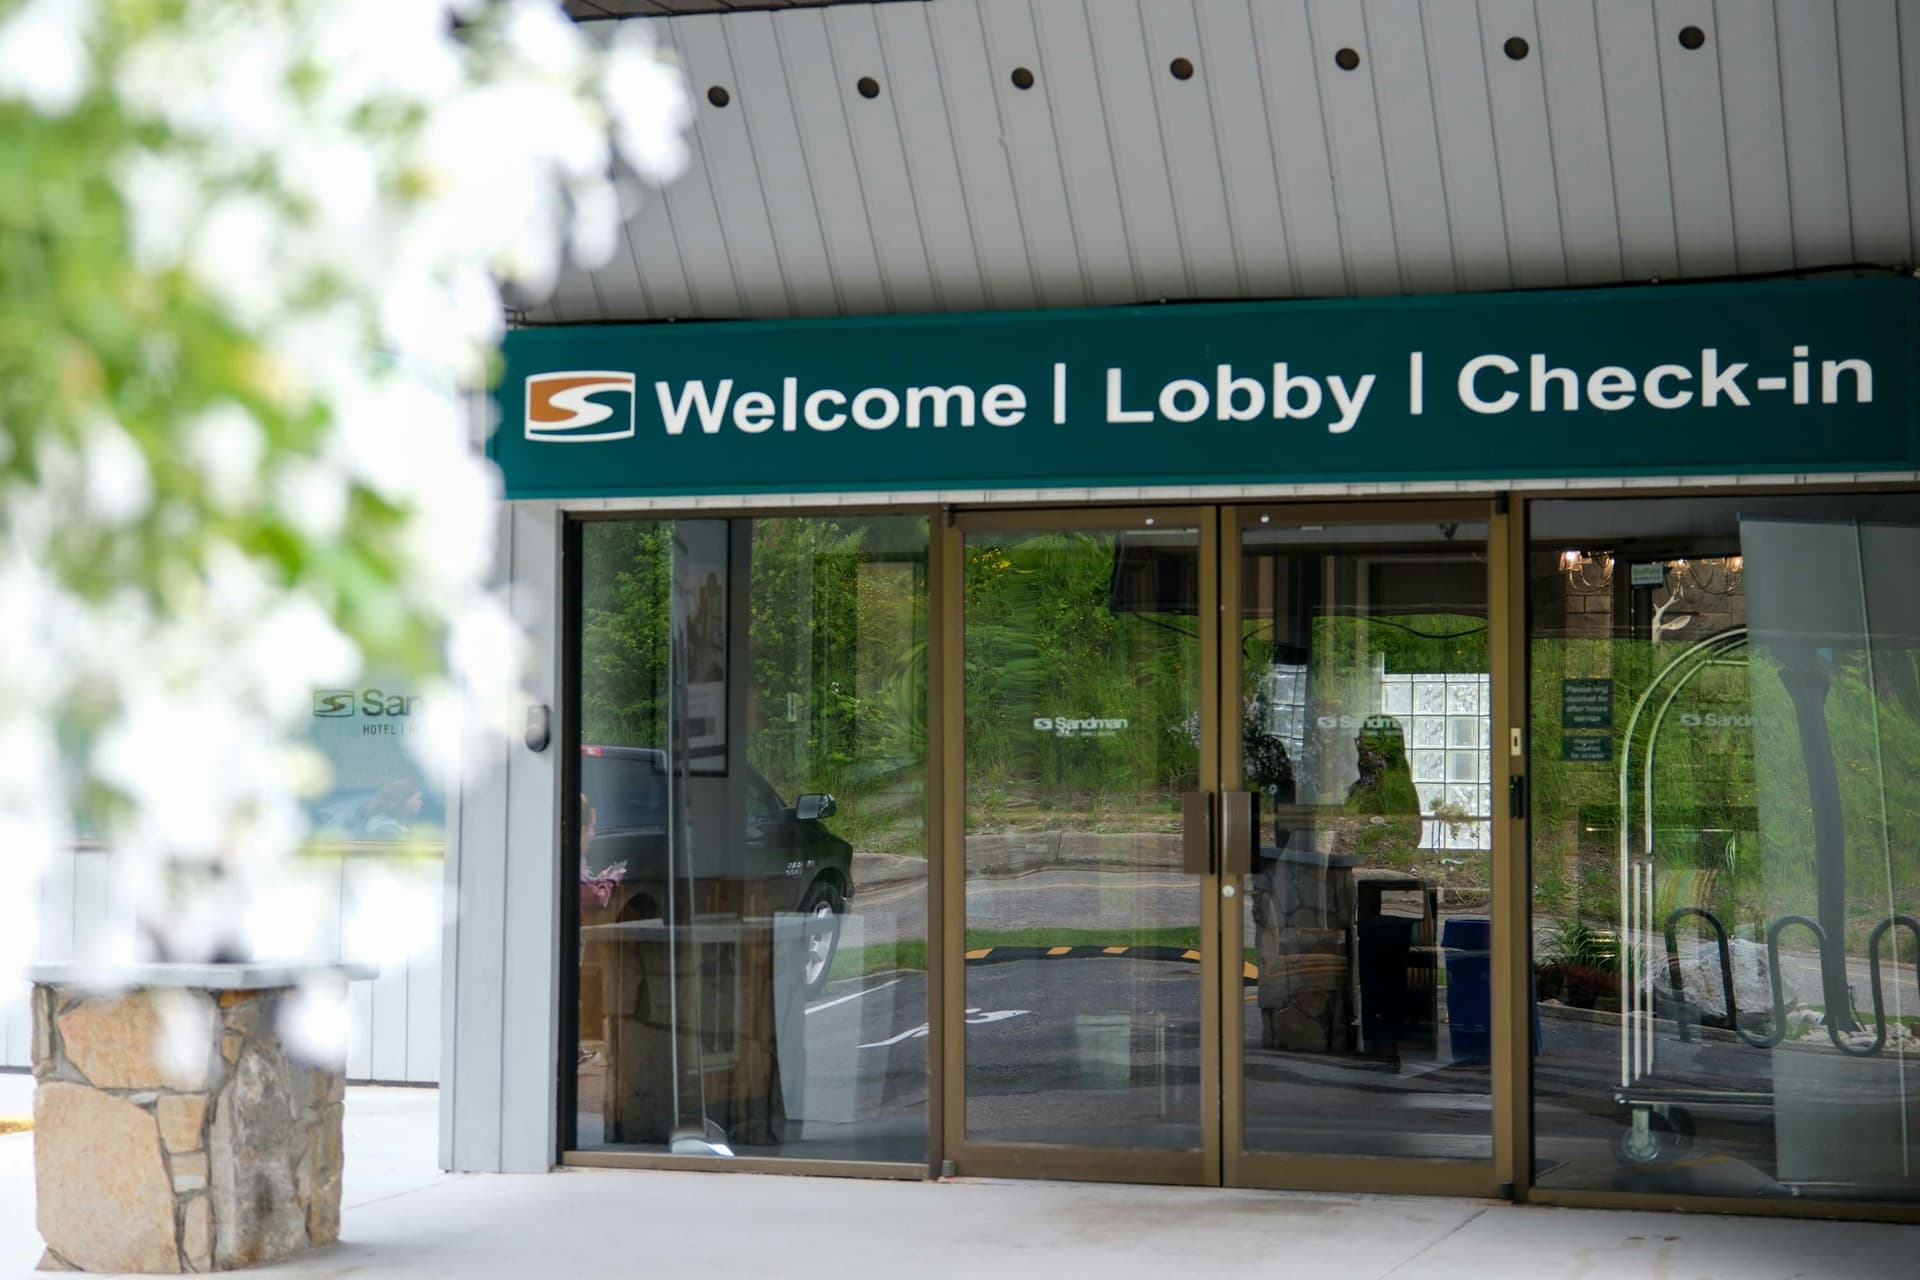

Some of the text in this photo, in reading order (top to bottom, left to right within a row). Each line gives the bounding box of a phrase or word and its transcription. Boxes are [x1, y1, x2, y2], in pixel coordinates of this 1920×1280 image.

[655, 377, 1026, 434] Welcome
[1107, 362, 1376, 433] Lobby
[1458, 346, 1872, 414] Check-in
[1056, 716, 1128, 729] Sandman
[1705, 712, 1776, 727] Sandm
[363, 724, 397, 735] HOTEL
